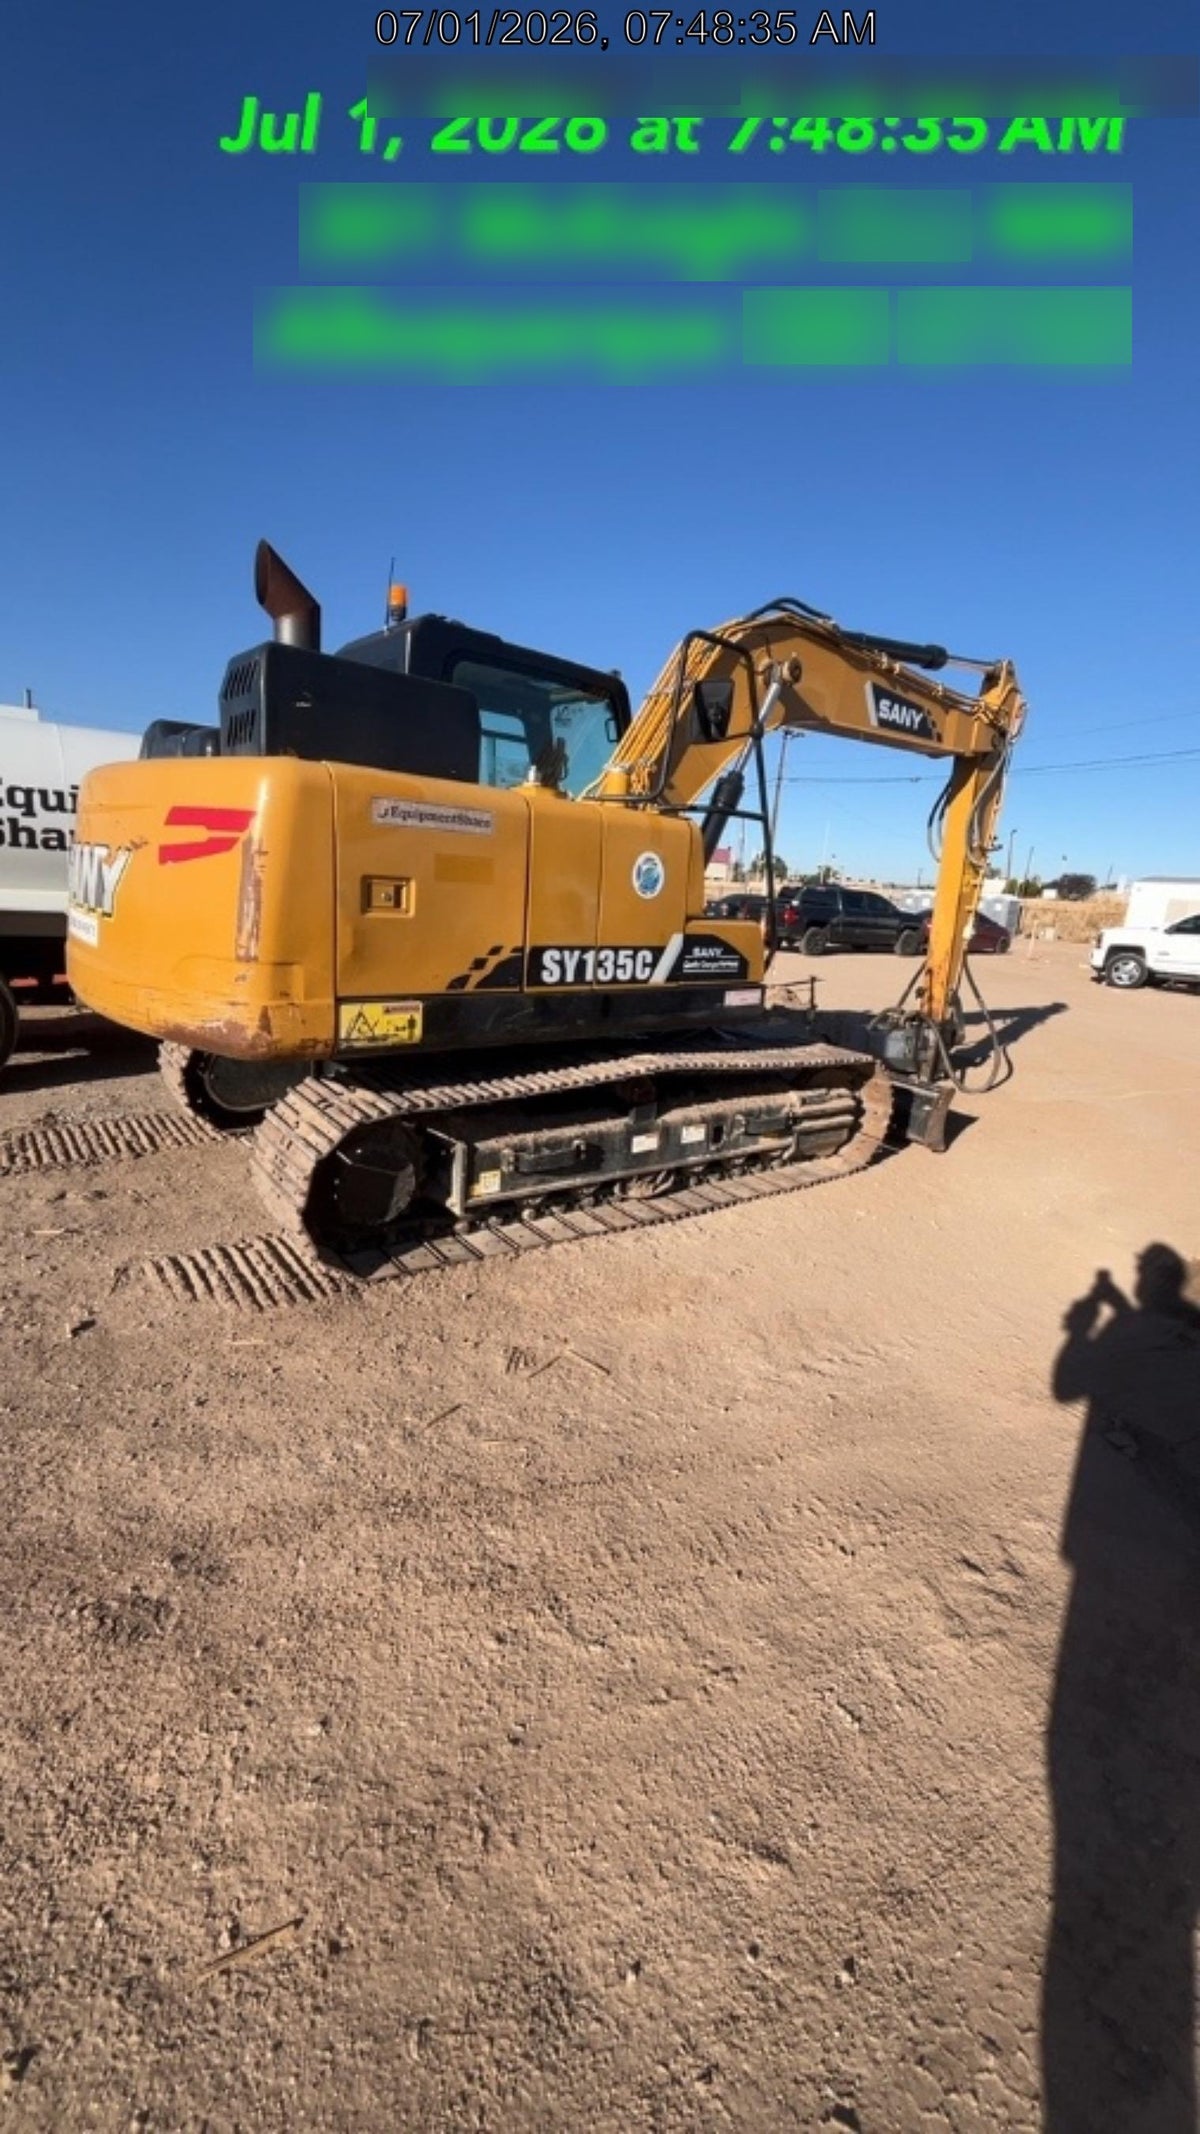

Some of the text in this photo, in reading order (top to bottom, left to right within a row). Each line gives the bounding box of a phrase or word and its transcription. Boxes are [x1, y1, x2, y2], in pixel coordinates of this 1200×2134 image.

[878, 698, 923, 731] SANY
[0, 776, 79, 818] qui
[0, 817, 76, 852] ha
[541, 948, 654, 984] SY135C
